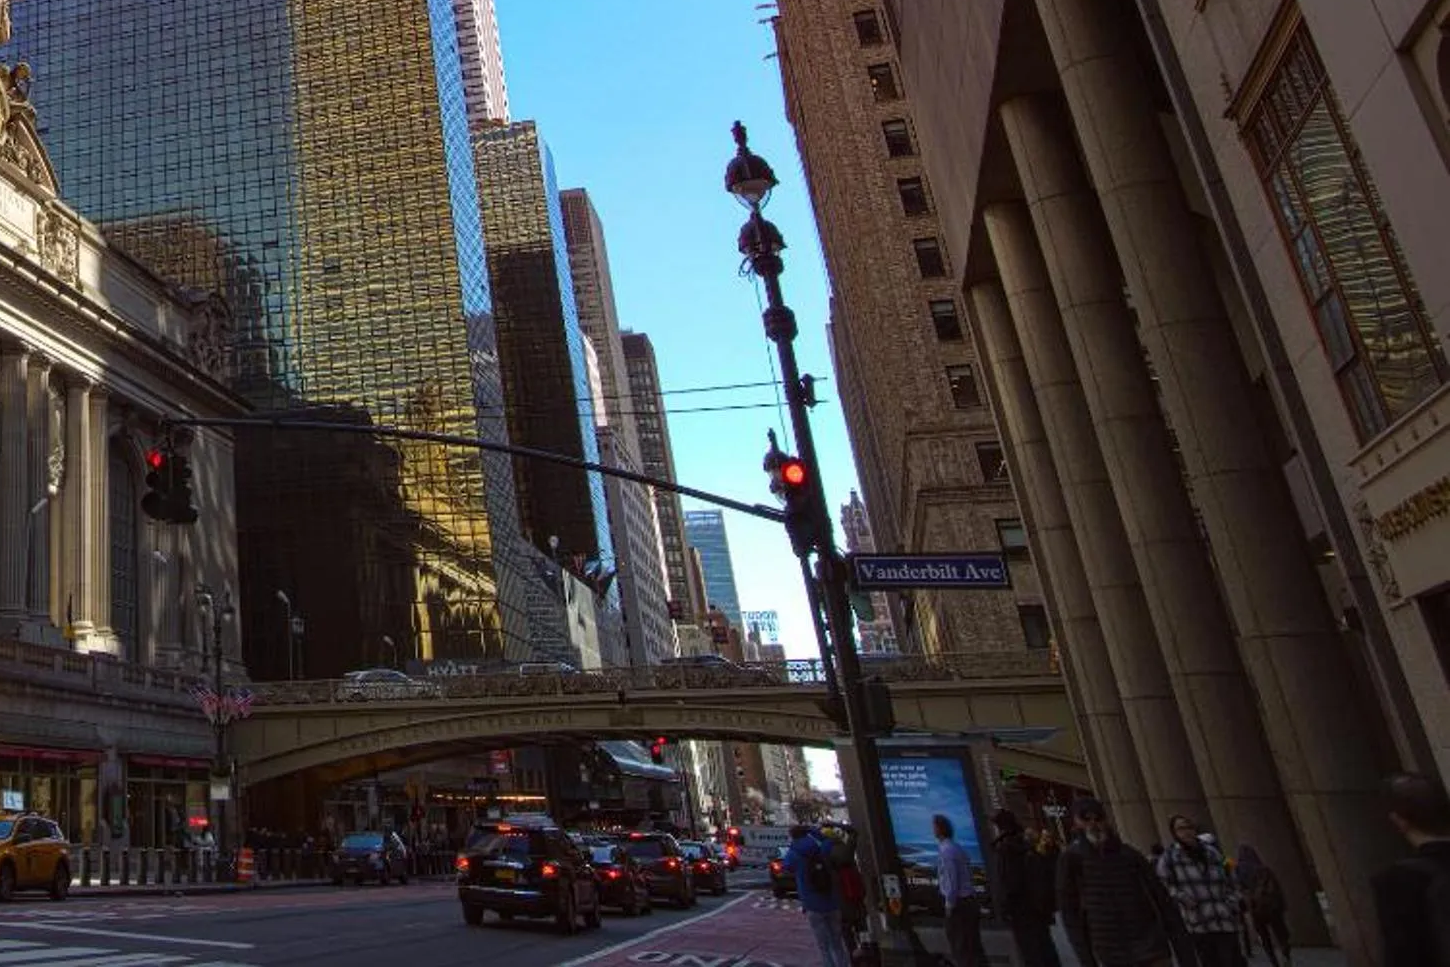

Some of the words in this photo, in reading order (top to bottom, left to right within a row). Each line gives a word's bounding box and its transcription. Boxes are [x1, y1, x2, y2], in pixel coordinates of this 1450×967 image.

[860, 563, 960, 580] Vanderbilt
[965, 563, 1000, 580] Ave
[427, 663, 479, 677] HYATT
